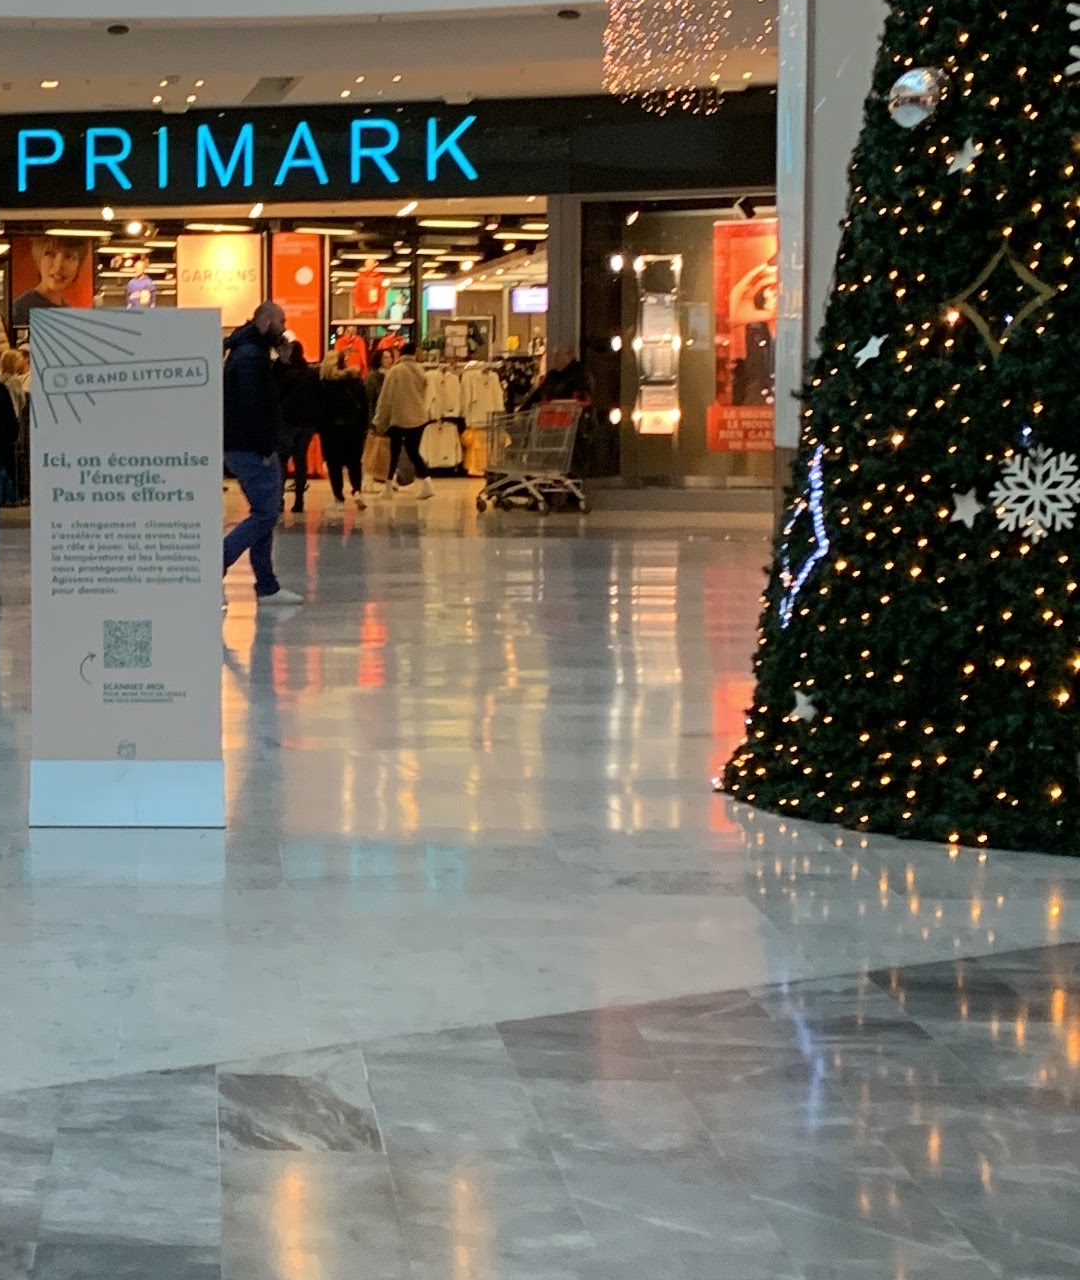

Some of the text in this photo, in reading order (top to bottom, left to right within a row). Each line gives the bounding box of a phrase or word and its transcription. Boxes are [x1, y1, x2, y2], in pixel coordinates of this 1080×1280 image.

[17, 115, 479, 193] PRIMARK
[74, 366, 203, 385] GRAND LITTORAL
[42, 452, 209, 468] Ici, on économise
[79, 470, 166, 487] l'énergie.
[52, 487, 195, 502] Pas nos efforts
[51, 521, 201, 530] Le changement climatique
[104, 532, 114, 540] et
[66, 542, 85, 551] rôle
[51, 553, 61, 561] la
[63, 553, 124, 563] température
[127, 553, 136, 561] et
[138, 553, 152, 561] les
[51, 575, 94, 585] Agissons
[51, 587, 75, 596] pour
